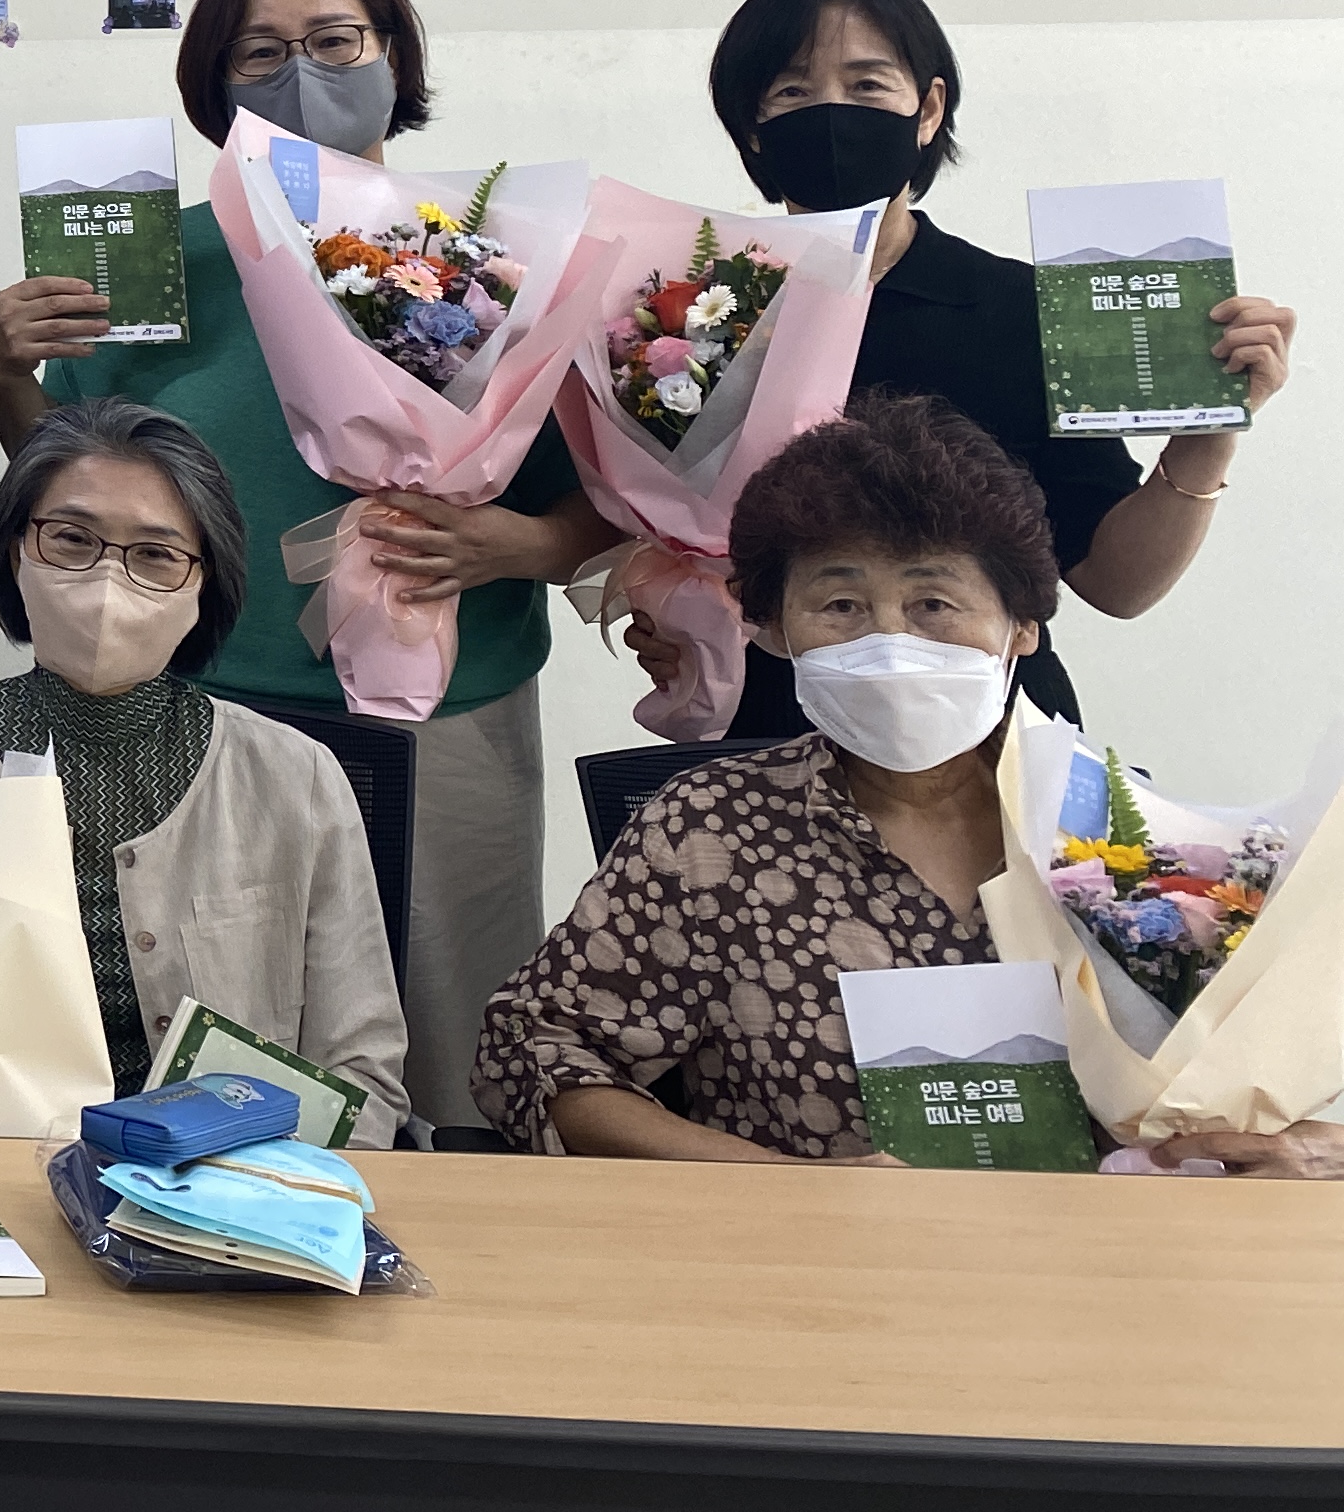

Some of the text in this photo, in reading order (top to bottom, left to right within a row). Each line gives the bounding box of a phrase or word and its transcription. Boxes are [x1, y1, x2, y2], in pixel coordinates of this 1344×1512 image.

[63, 202, 134, 220] 인문 숲으로
[64, 219, 134, 237] 떠나는 여행
[1090, 273, 1180, 292] 인문 숲으로
[1092, 292, 1181, 311] 떠나는 여행
[920, 1079, 1021, 1103] 인문 숲으로
[925, 1102, 1025, 1126] 떠나는 여행
